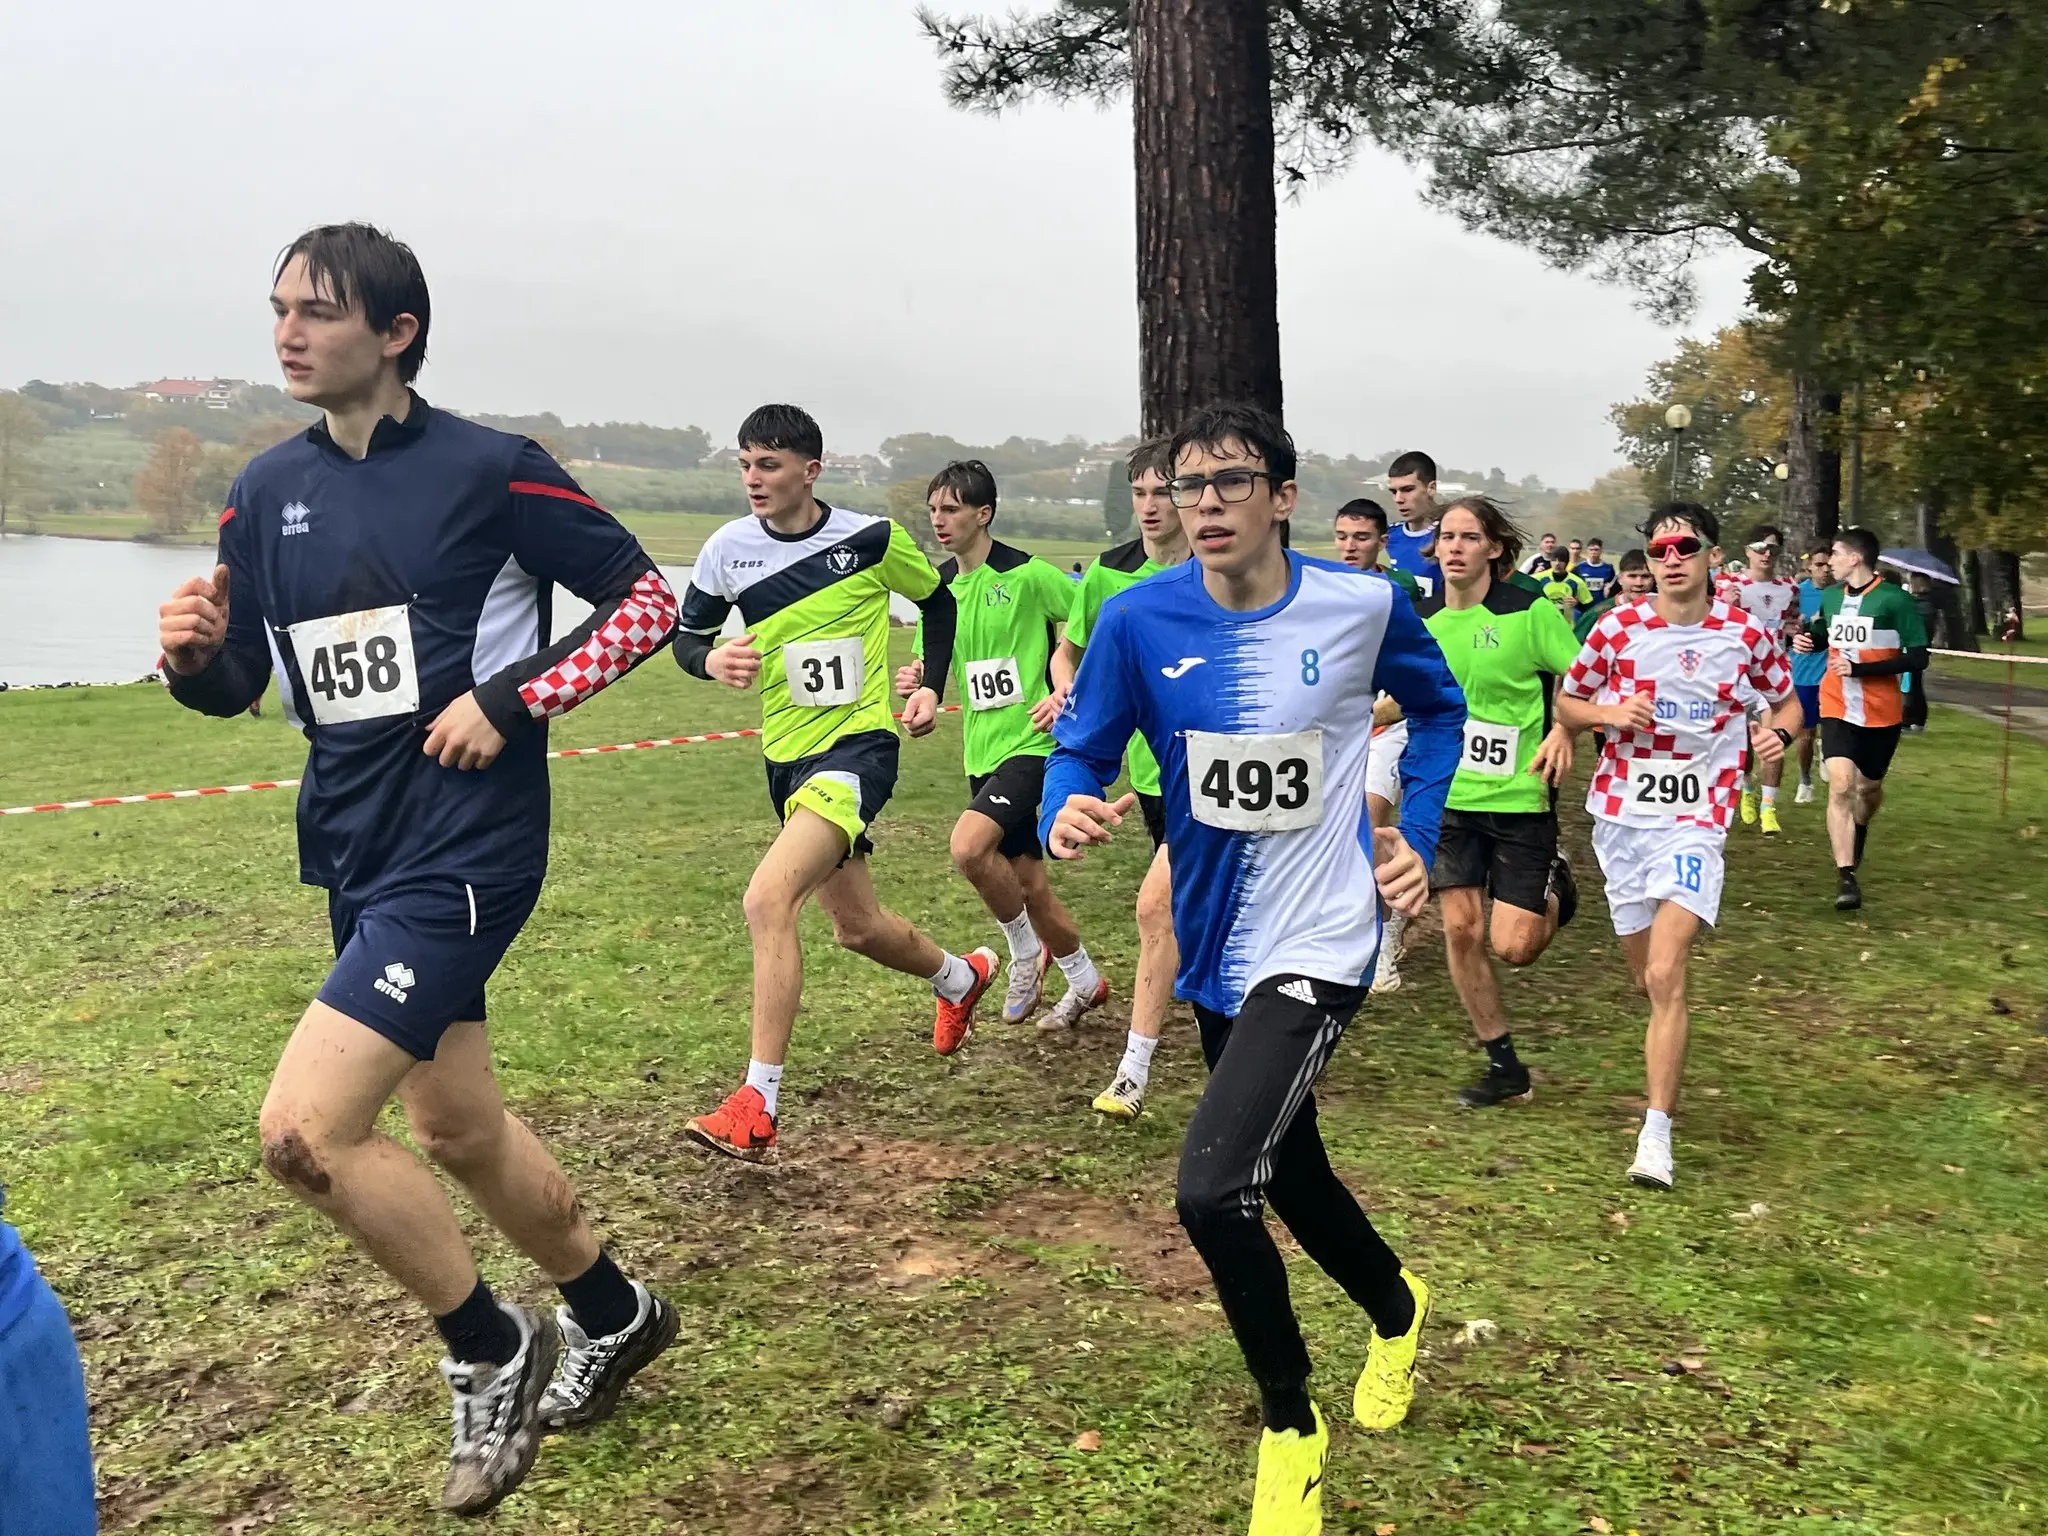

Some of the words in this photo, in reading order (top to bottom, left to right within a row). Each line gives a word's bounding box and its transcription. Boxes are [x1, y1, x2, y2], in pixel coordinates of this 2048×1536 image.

[731, 559, 764, 570] Zeus
[1834, 624, 1867, 643] 200
[311, 635, 401, 701] 458
[802, 655, 844, 693] 31
[1300, 648, 1320, 686] 8
[970, 669, 1014, 700] 196
[1470, 735, 1508, 766] 95
[1200, 757, 1309, 812] 493
[1636, 773, 1700, 804] 290
[1673, 854, 1702, 893] 18
[1277, 985, 1317, 1005] adidas
